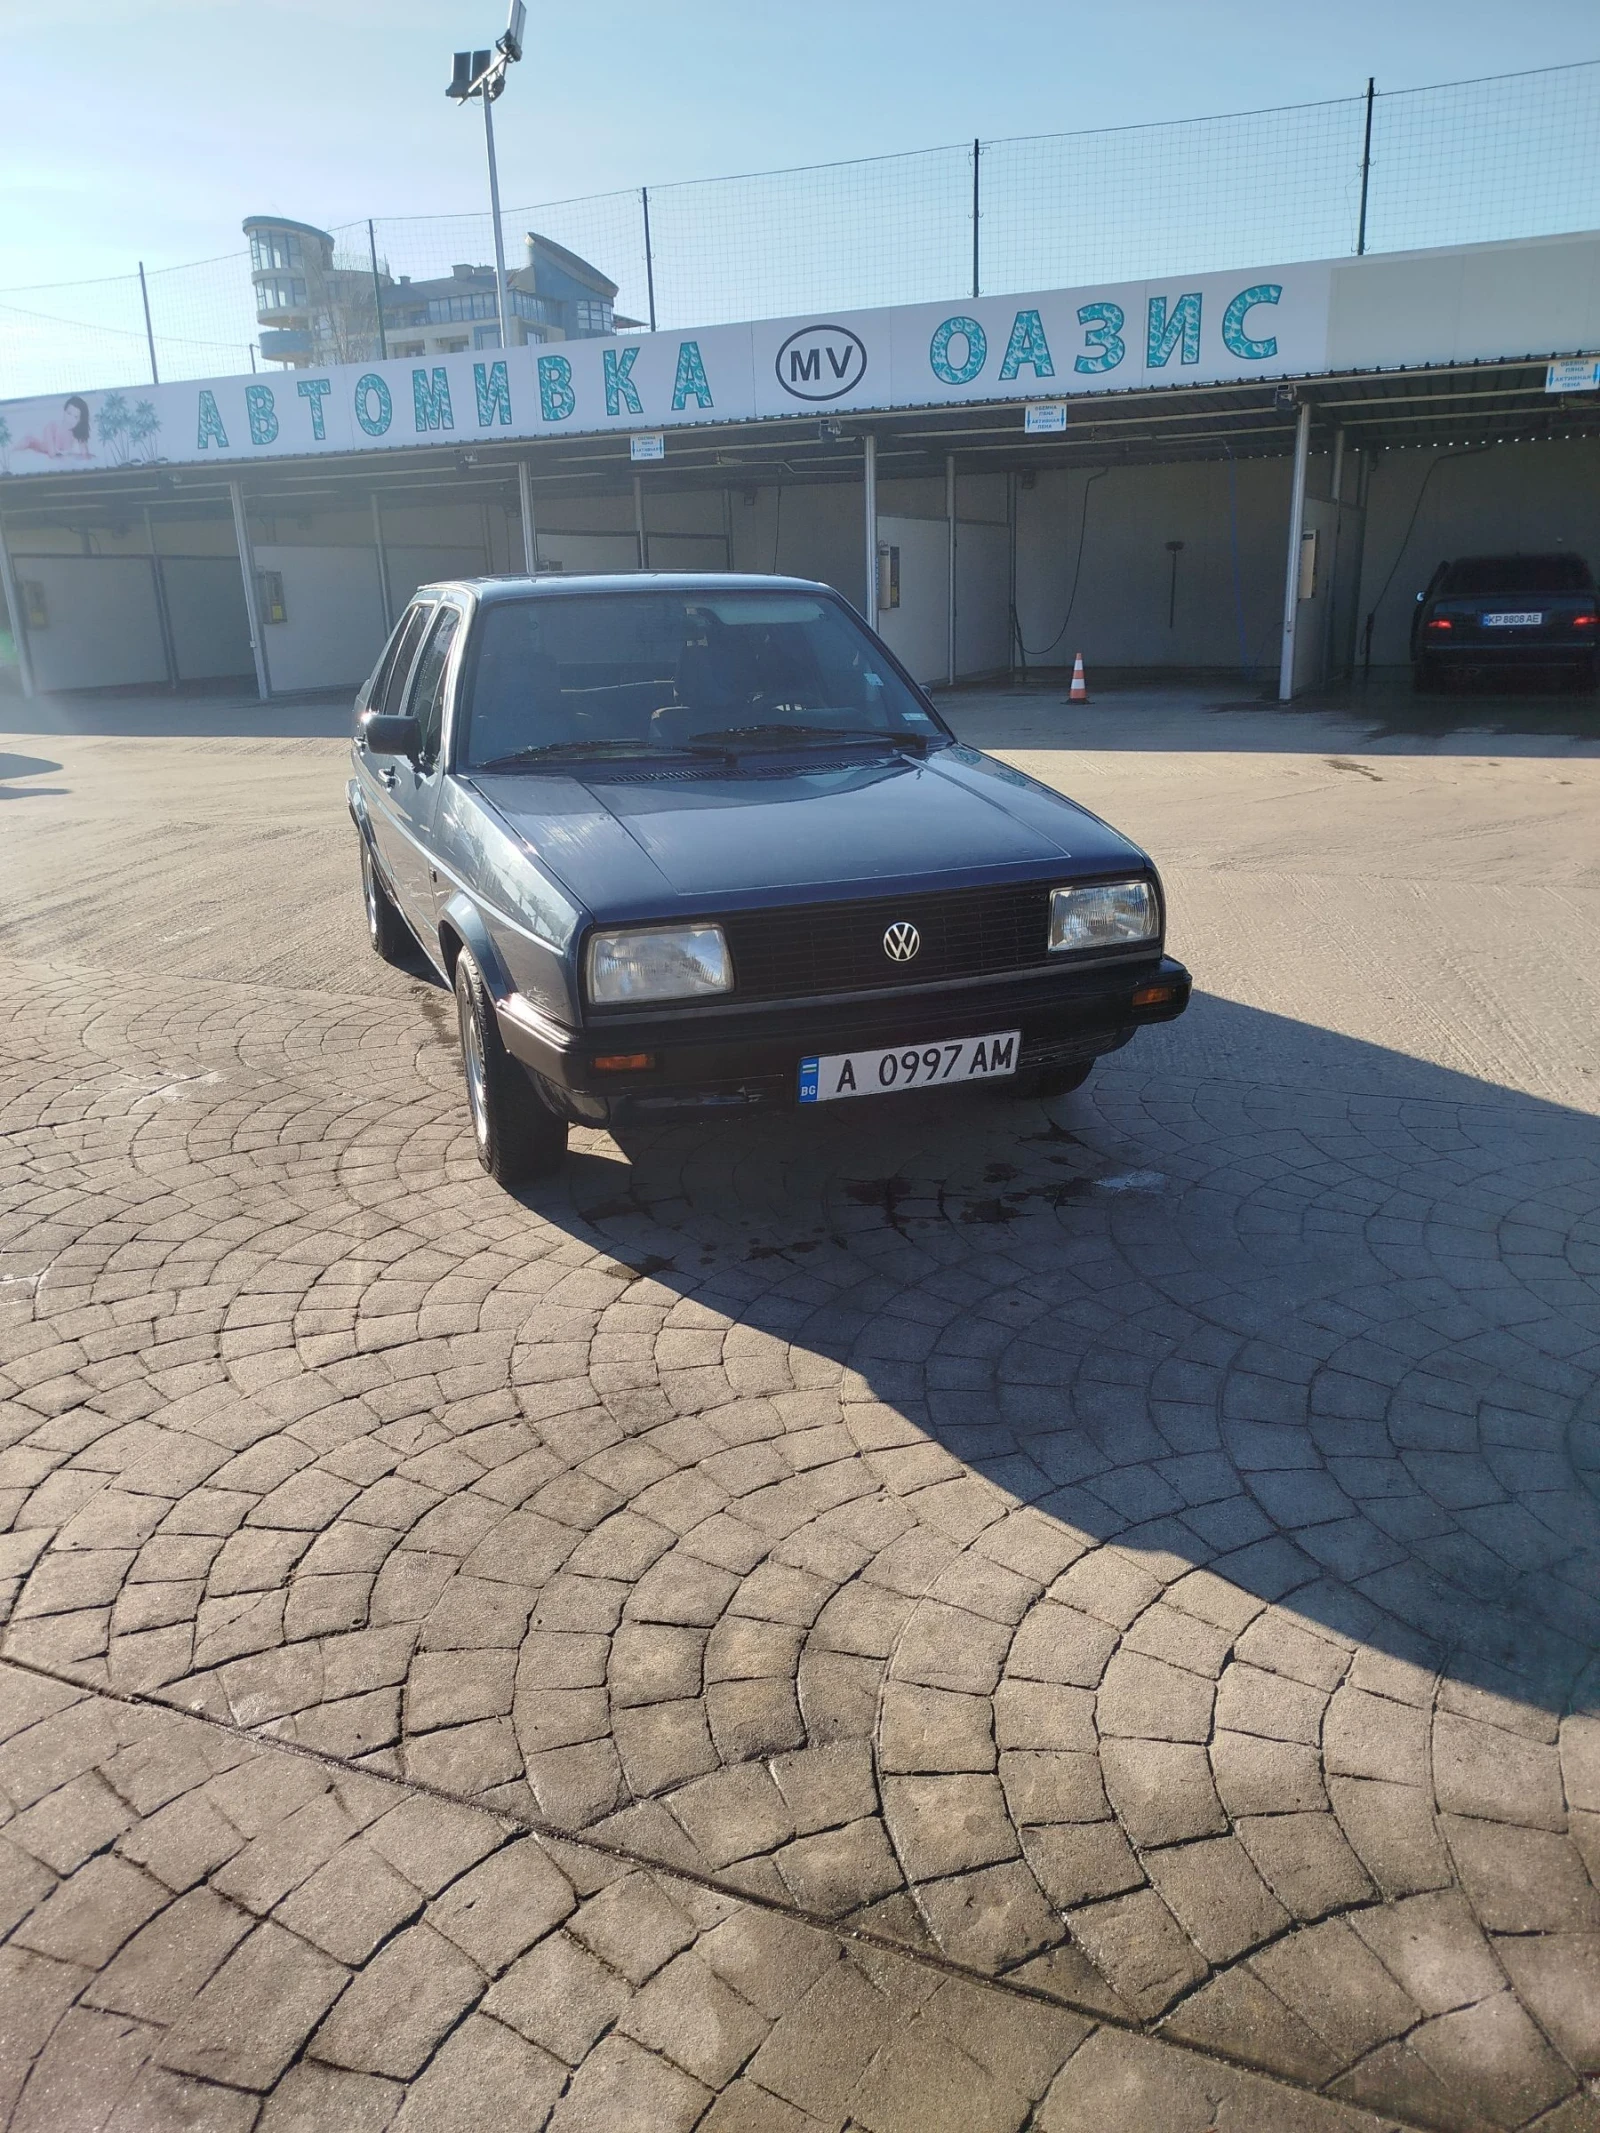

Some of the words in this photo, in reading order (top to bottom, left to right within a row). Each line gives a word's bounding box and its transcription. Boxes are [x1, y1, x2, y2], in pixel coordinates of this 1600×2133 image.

[929, 283, 1284, 386] ОАЗИС
[790, 345, 854, 382] MV
[197, 340, 715, 450] АВТОМИВКА
[1526, 614, 1540, 623] AE
[884, 922, 920, 961] VW
[836, 1059, 857, 1092] A
[878, 1044, 963, 1087] 0997
[968, 1037, 1015, 1075] AM
[800, 1086, 816, 1097] BG
